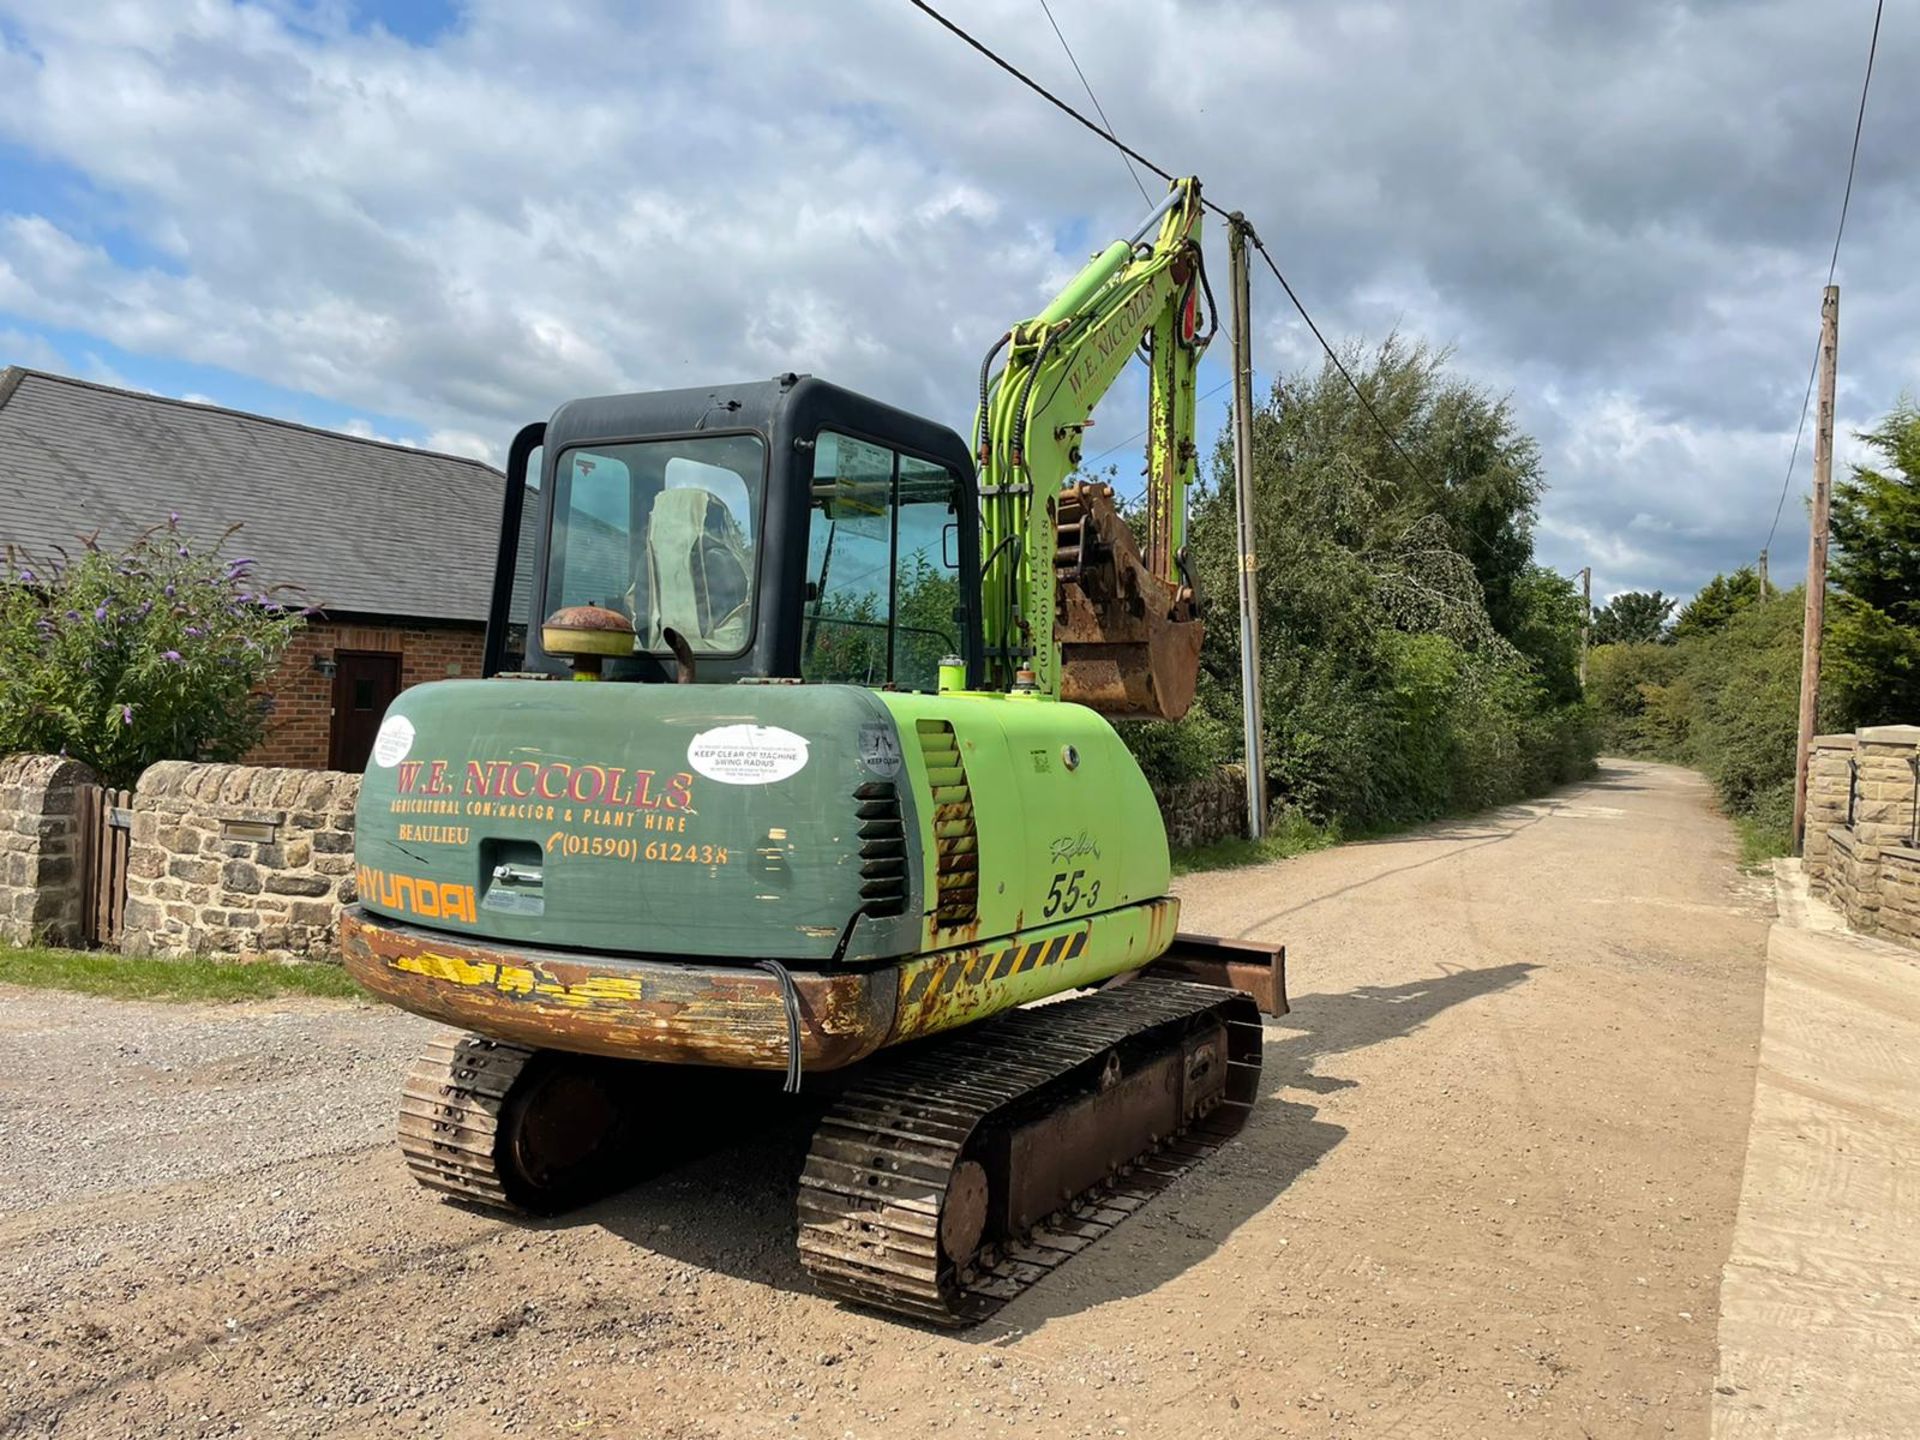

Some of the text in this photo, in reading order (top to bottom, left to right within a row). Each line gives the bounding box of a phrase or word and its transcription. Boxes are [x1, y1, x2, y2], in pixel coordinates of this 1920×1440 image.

[694, 750, 798, 761] KEEP CLEAR OF MACHINE
[714, 759, 775, 767] SWING RADIUS
[398, 759, 694, 811] W.E. NICCOLLS
[390, 799, 460, 815] AGRICULTURAL
[564, 808, 573, 822] &
[583, 808, 634, 828] PLANT
[644, 812, 686, 833] HIRE
[399, 824, 470, 845] BEAULIEU
[563, 833, 728, 864] (01590) 612438
[355, 864, 478, 924] HYUNDAI
[1043, 869, 1101, 919] 55-3
